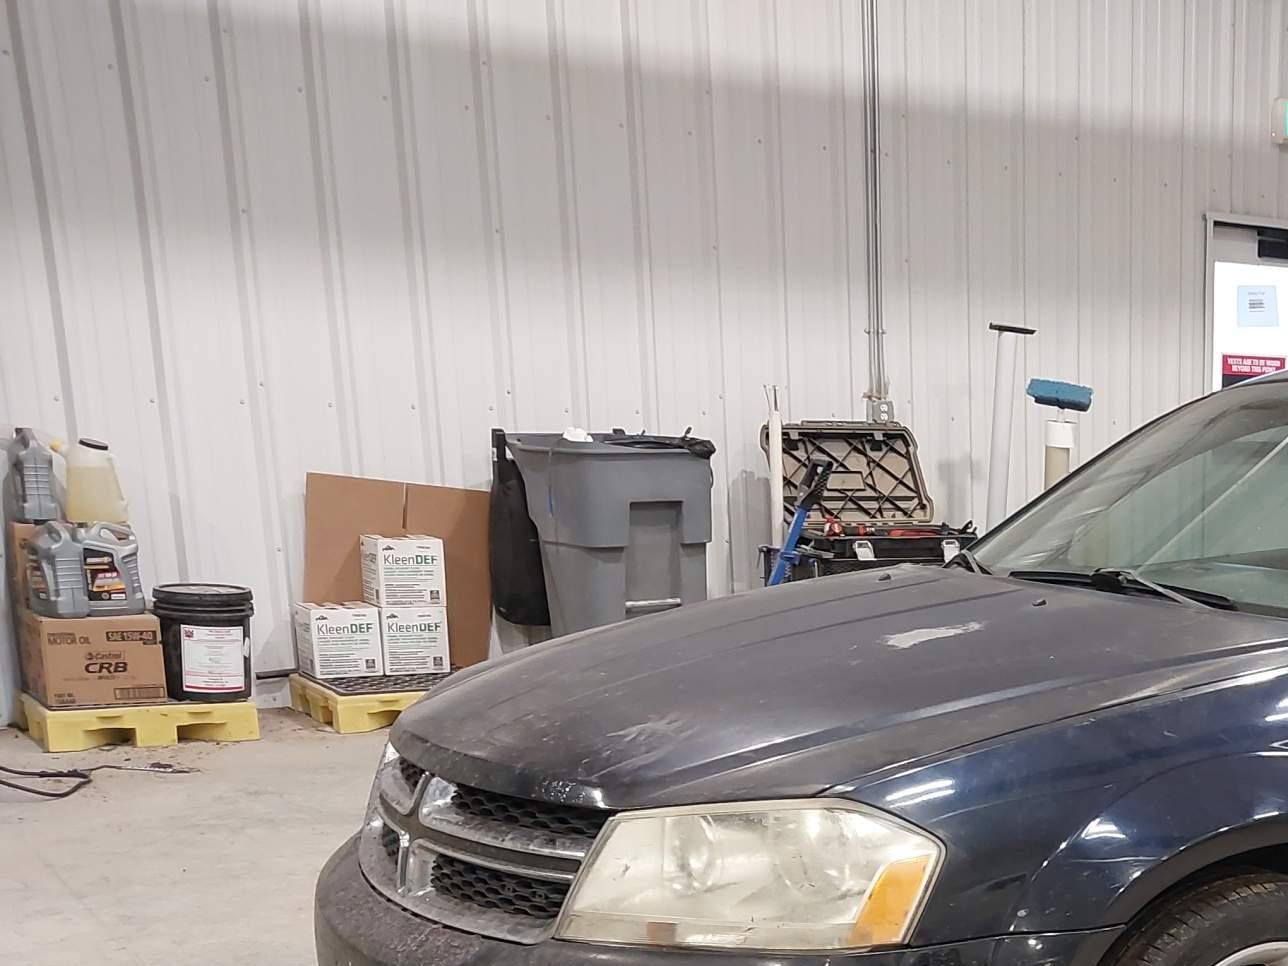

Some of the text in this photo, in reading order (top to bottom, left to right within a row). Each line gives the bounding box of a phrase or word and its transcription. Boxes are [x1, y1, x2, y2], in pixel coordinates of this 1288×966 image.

[383, 554, 438, 565] KleenDEF
[317, 623, 374, 635] KleenDEF
[387, 622, 442, 633] KleenDEF
[48, 636, 91, 645] MOTOR OIL
[108, 632, 123, 640] SAE
[94, 652, 122, 660] Castrol
[84, 662, 128, 673] CRB
